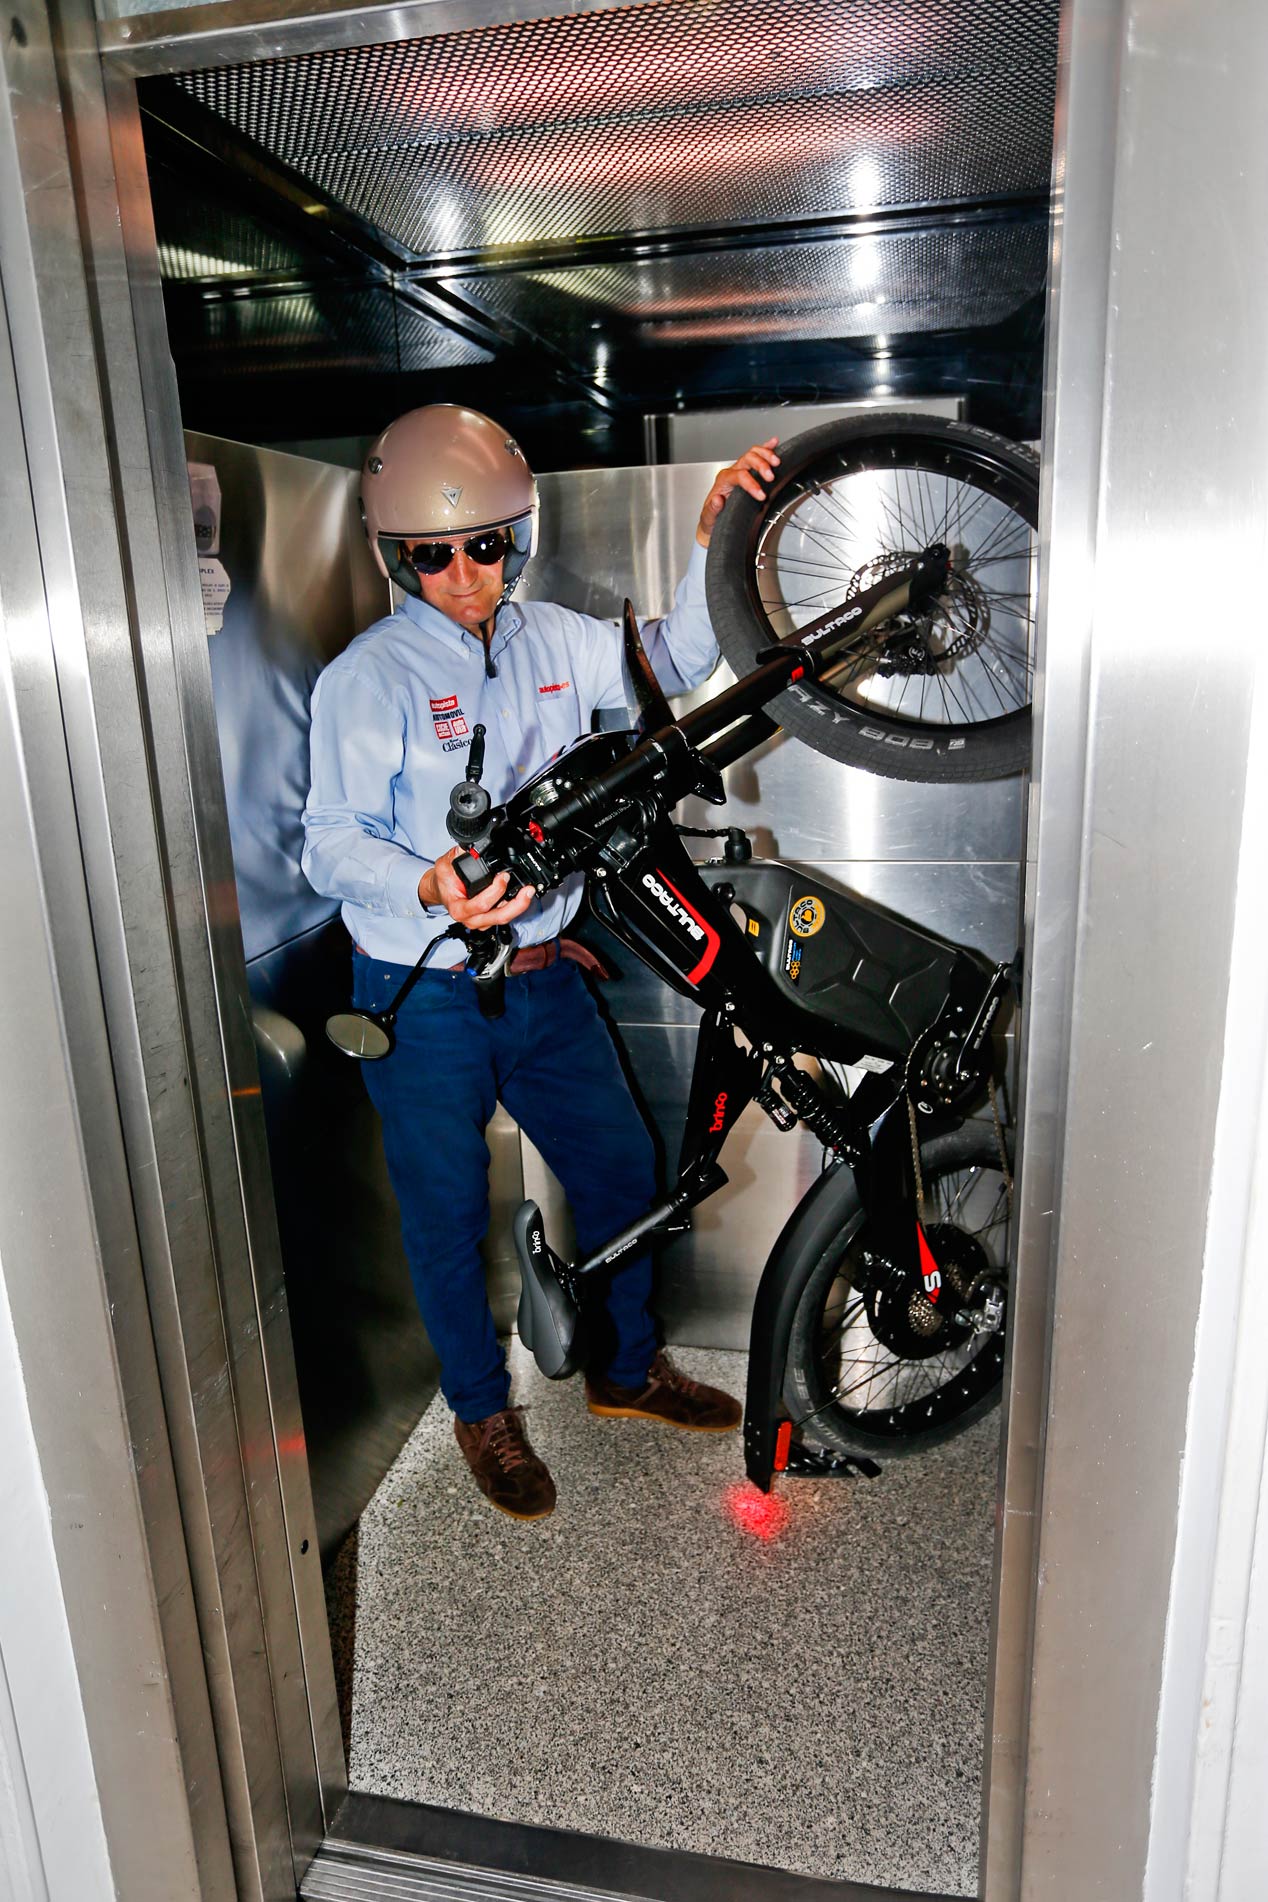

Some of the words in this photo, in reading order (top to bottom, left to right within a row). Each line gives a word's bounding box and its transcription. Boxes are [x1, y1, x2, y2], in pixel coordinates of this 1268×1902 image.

[801, 606, 863, 646] BULTACO
[641, 873, 706, 941] BULTACO
[605, 1238, 638, 1264] BULTACO
